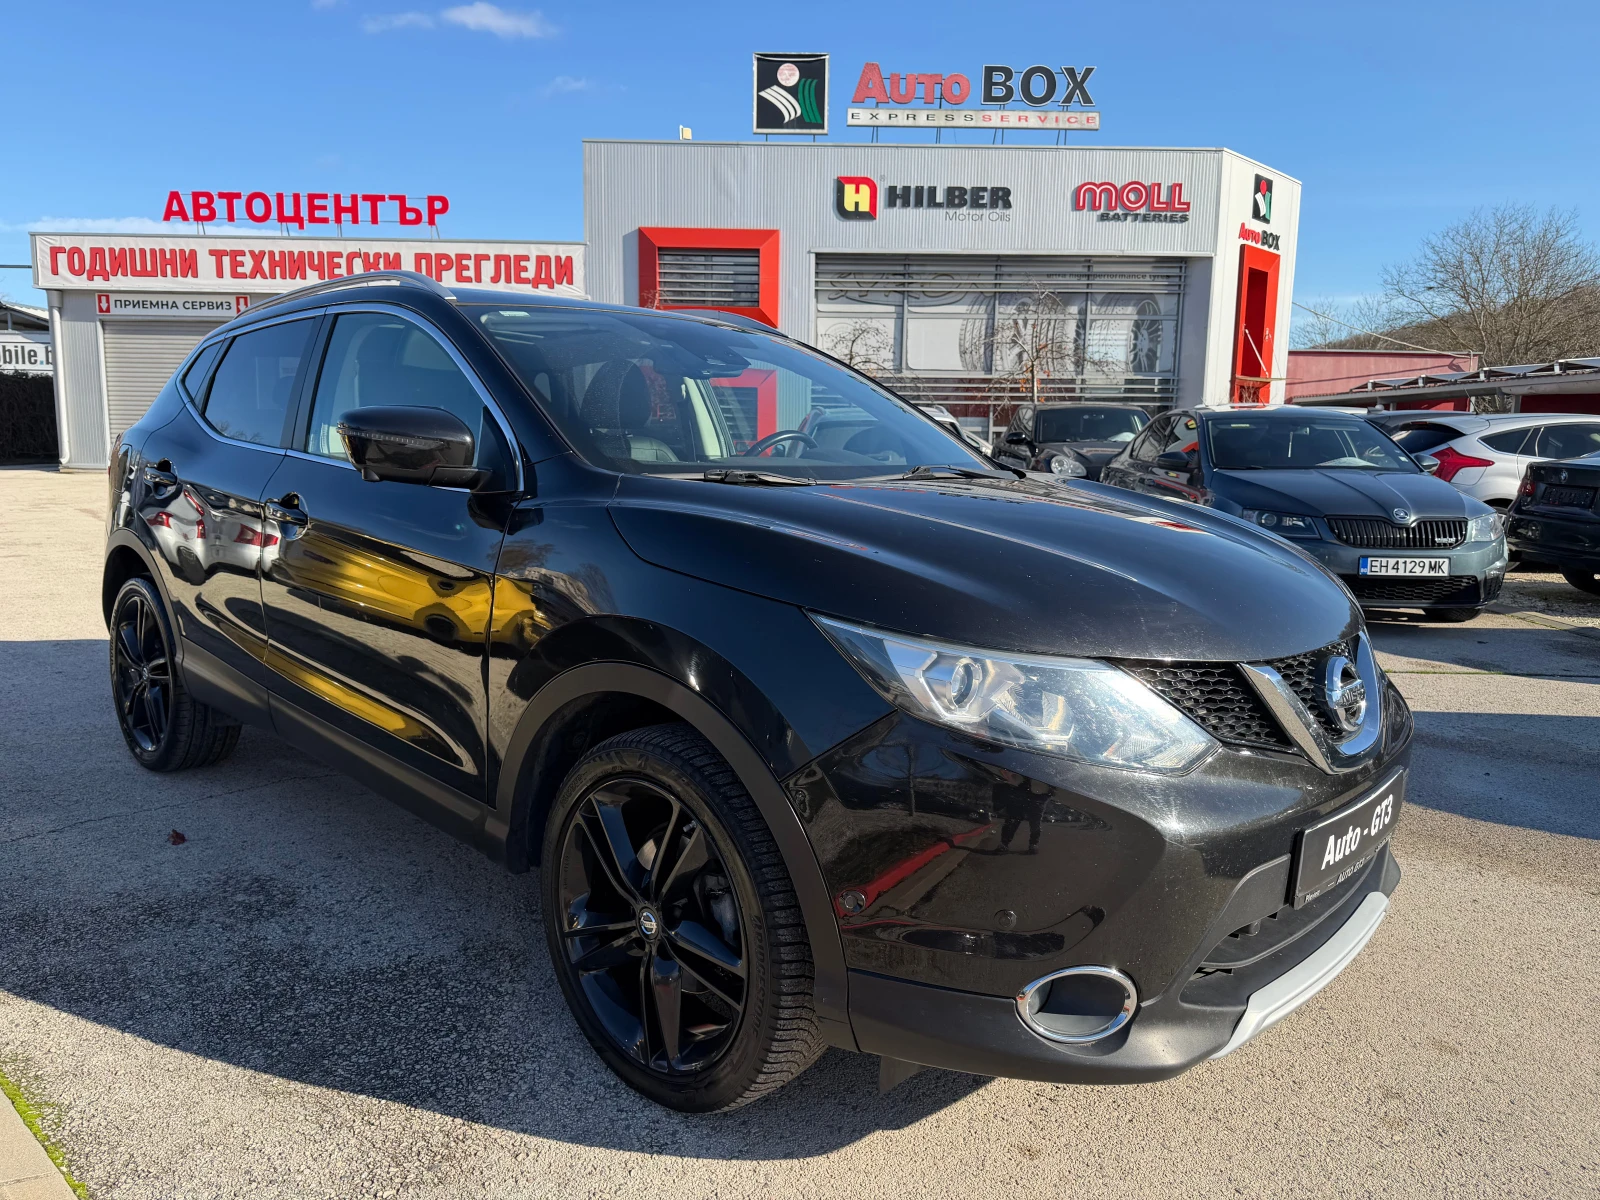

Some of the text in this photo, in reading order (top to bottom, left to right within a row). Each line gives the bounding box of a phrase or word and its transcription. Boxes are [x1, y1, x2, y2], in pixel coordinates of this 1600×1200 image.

[980, 64, 1097, 107] BOX
[888, 185, 1012, 209] HILBER
[162, 190, 450, 230] АВТОЦЕНТЪР
[944, 211, 1011, 222] Motor Oils
[1099, 212, 1190, 223] BATTERIES
[1261, 230, 1281, 251] BOX
[49, 246, 574, 290] ГОДИШНИ ТЕХНИЧЕСКИ ПРЕГЛЕДИ
[114, 299, 232, 311] ПРИЕМНА СЕРВИЗ
[1391, 560, 1426, 574] 4129
[1320, 825, 1361, 871] Auto
[1370, 793, 1394, 837] GT3
